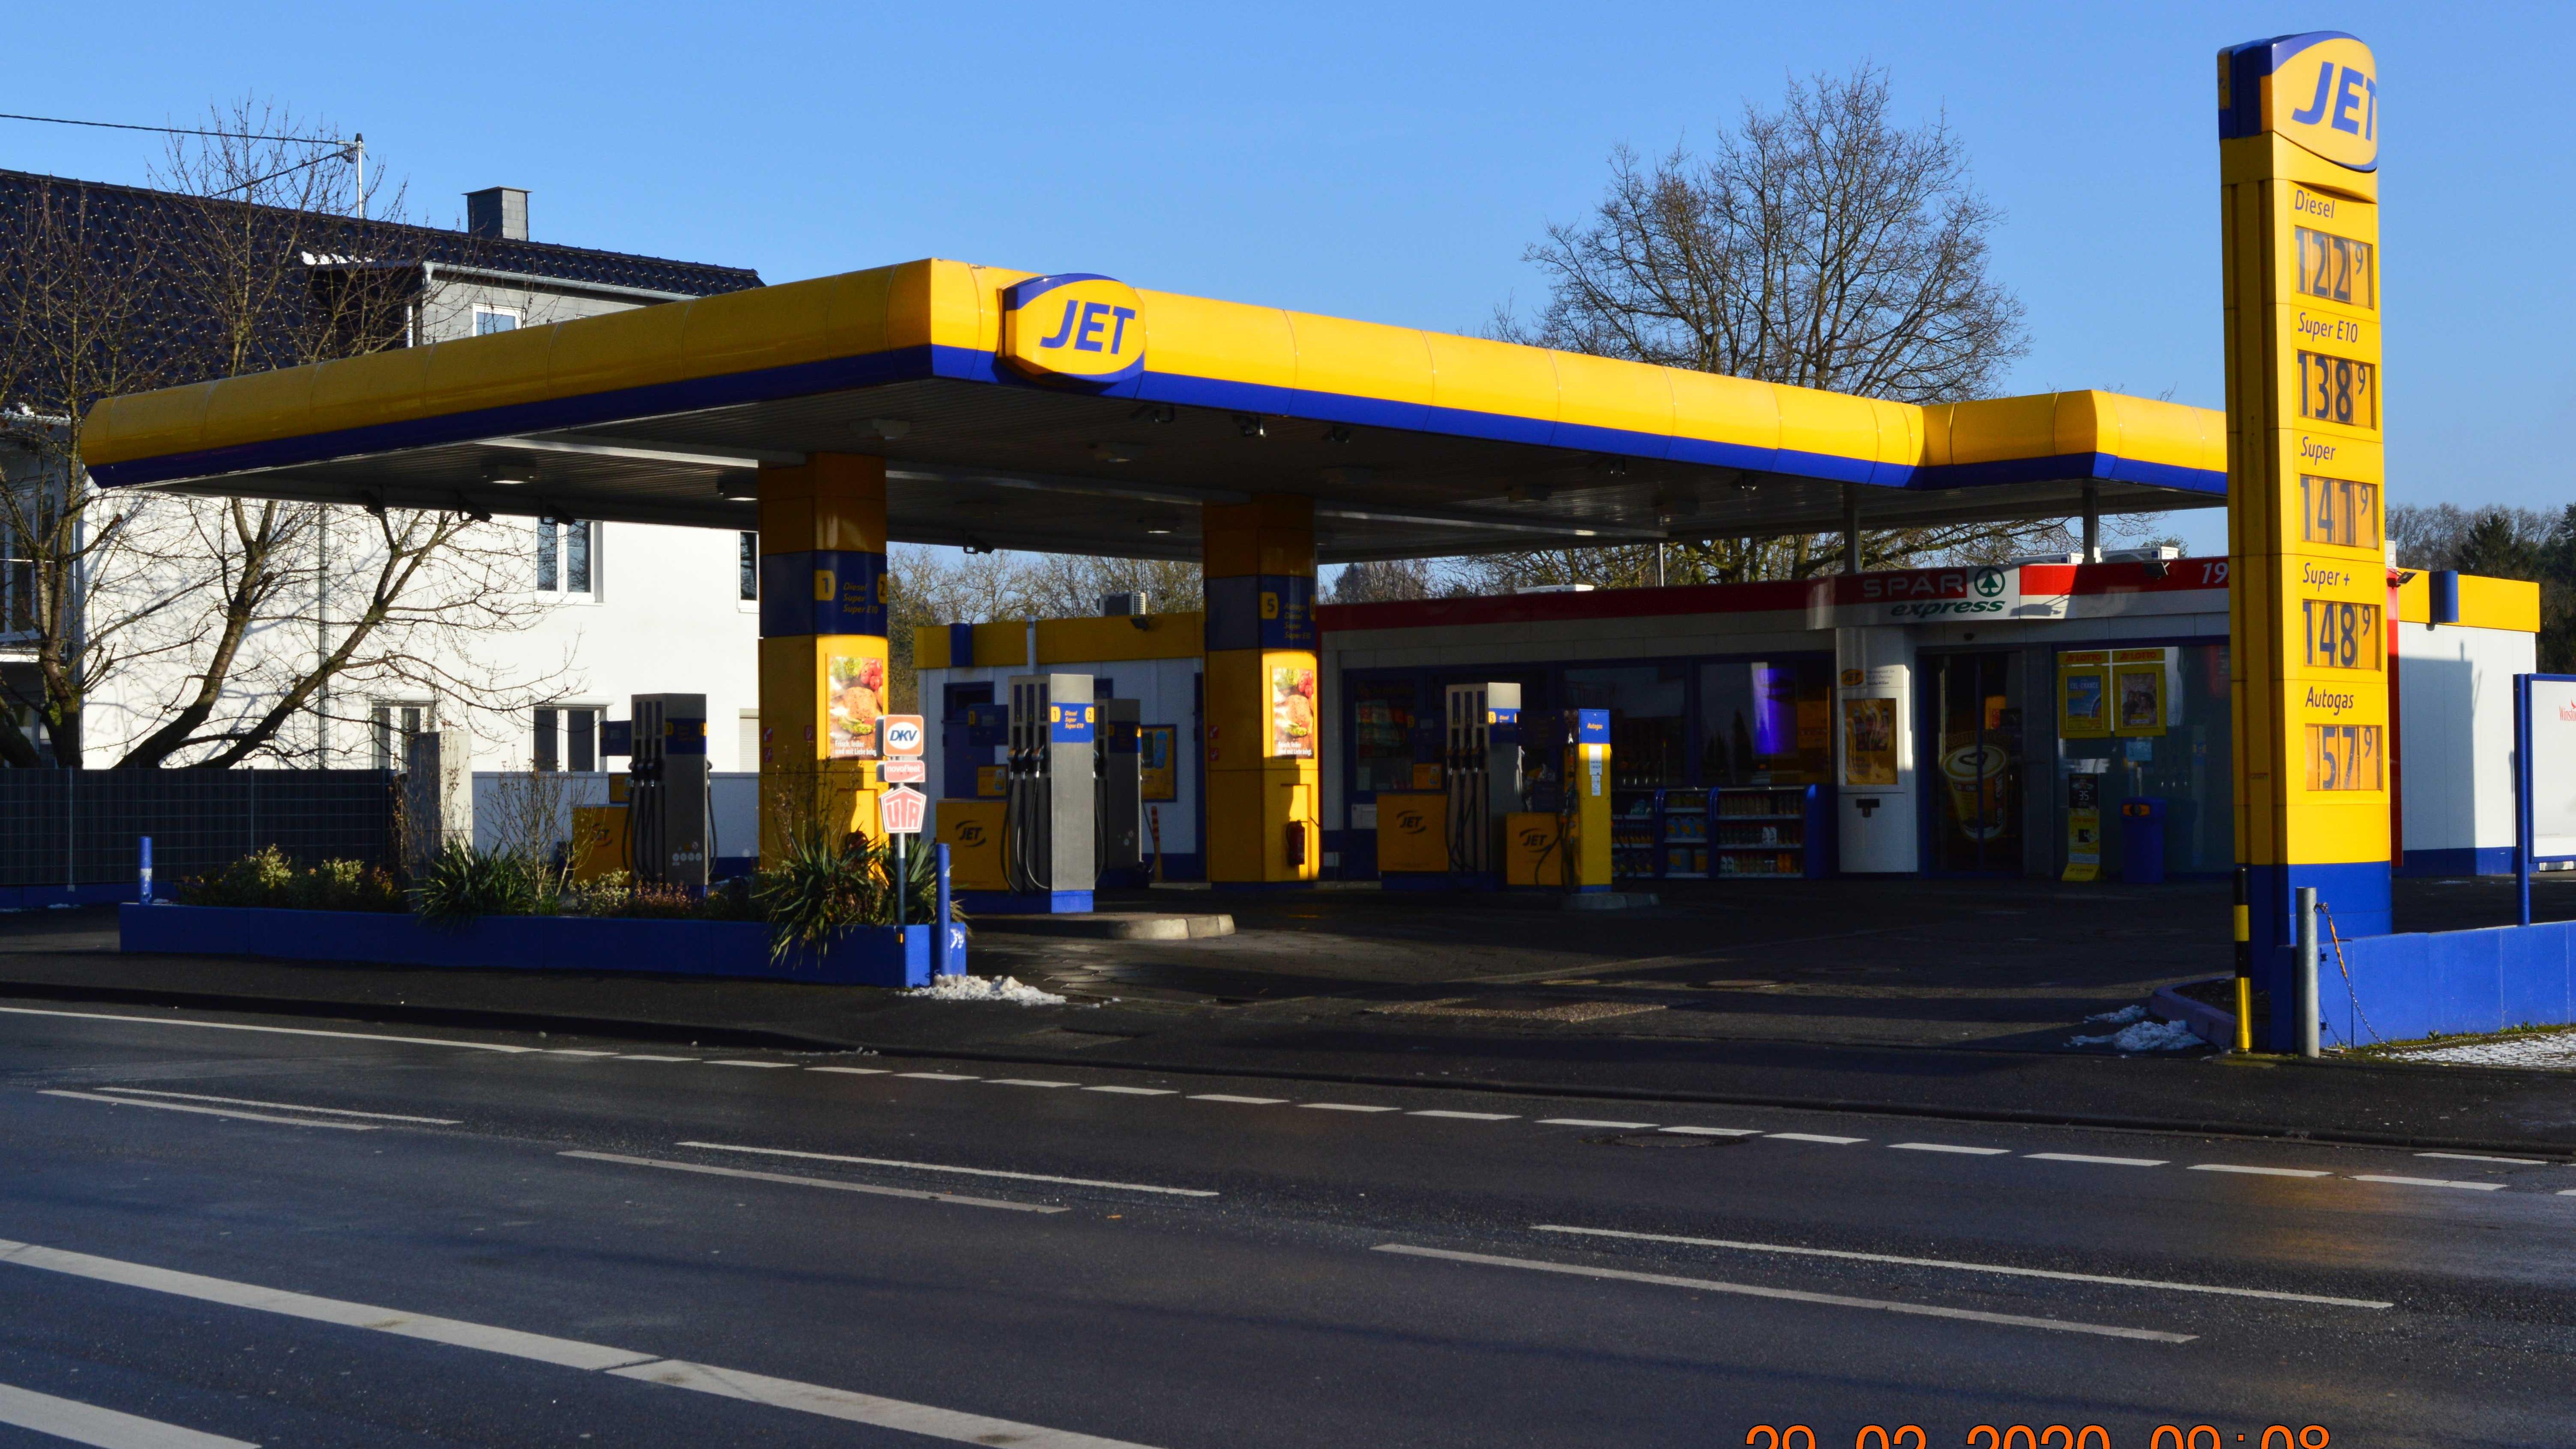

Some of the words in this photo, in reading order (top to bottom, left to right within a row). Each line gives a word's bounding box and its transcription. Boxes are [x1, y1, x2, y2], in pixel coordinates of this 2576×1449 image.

[2291, 61, 2376, 142] JET
[2294, 189, 2335, 219] Diesel
[1039, 299, 1136, 355] JET
[2298, 311, 2333, 342] Super
[2337, 319, 2358, 343] E10
[2301, 436, 2336, 465] Super
[2303, 562, 2340, 592] Super
[822, 577, 829, 593] 1
[843, 581, 868, 591] Diesel
[880, 580, 885, 596] 2
[1863, 573, 1964, 598] SPAR
[843, 593, 865, 603] Super
[843, 604, 866, 614] Super
[1890, 600, 2007, 618] express
[2075, 653, 2102, 662] LOTTO
[2130, 651, 2157, 659] LOTTO
[2305, 686, 2354, 716] Autogas
[1053, 710, 1056, 719] 1
[1088, 711, 1092, 719] 2
[889, 730, 918, 742] DKV
[2078, 790, 2090, 801] 35
[1399, 816, 1423, 828] JET
[959, 827, 983, 841] JET
[1522, 834, 1548, 847] JET
